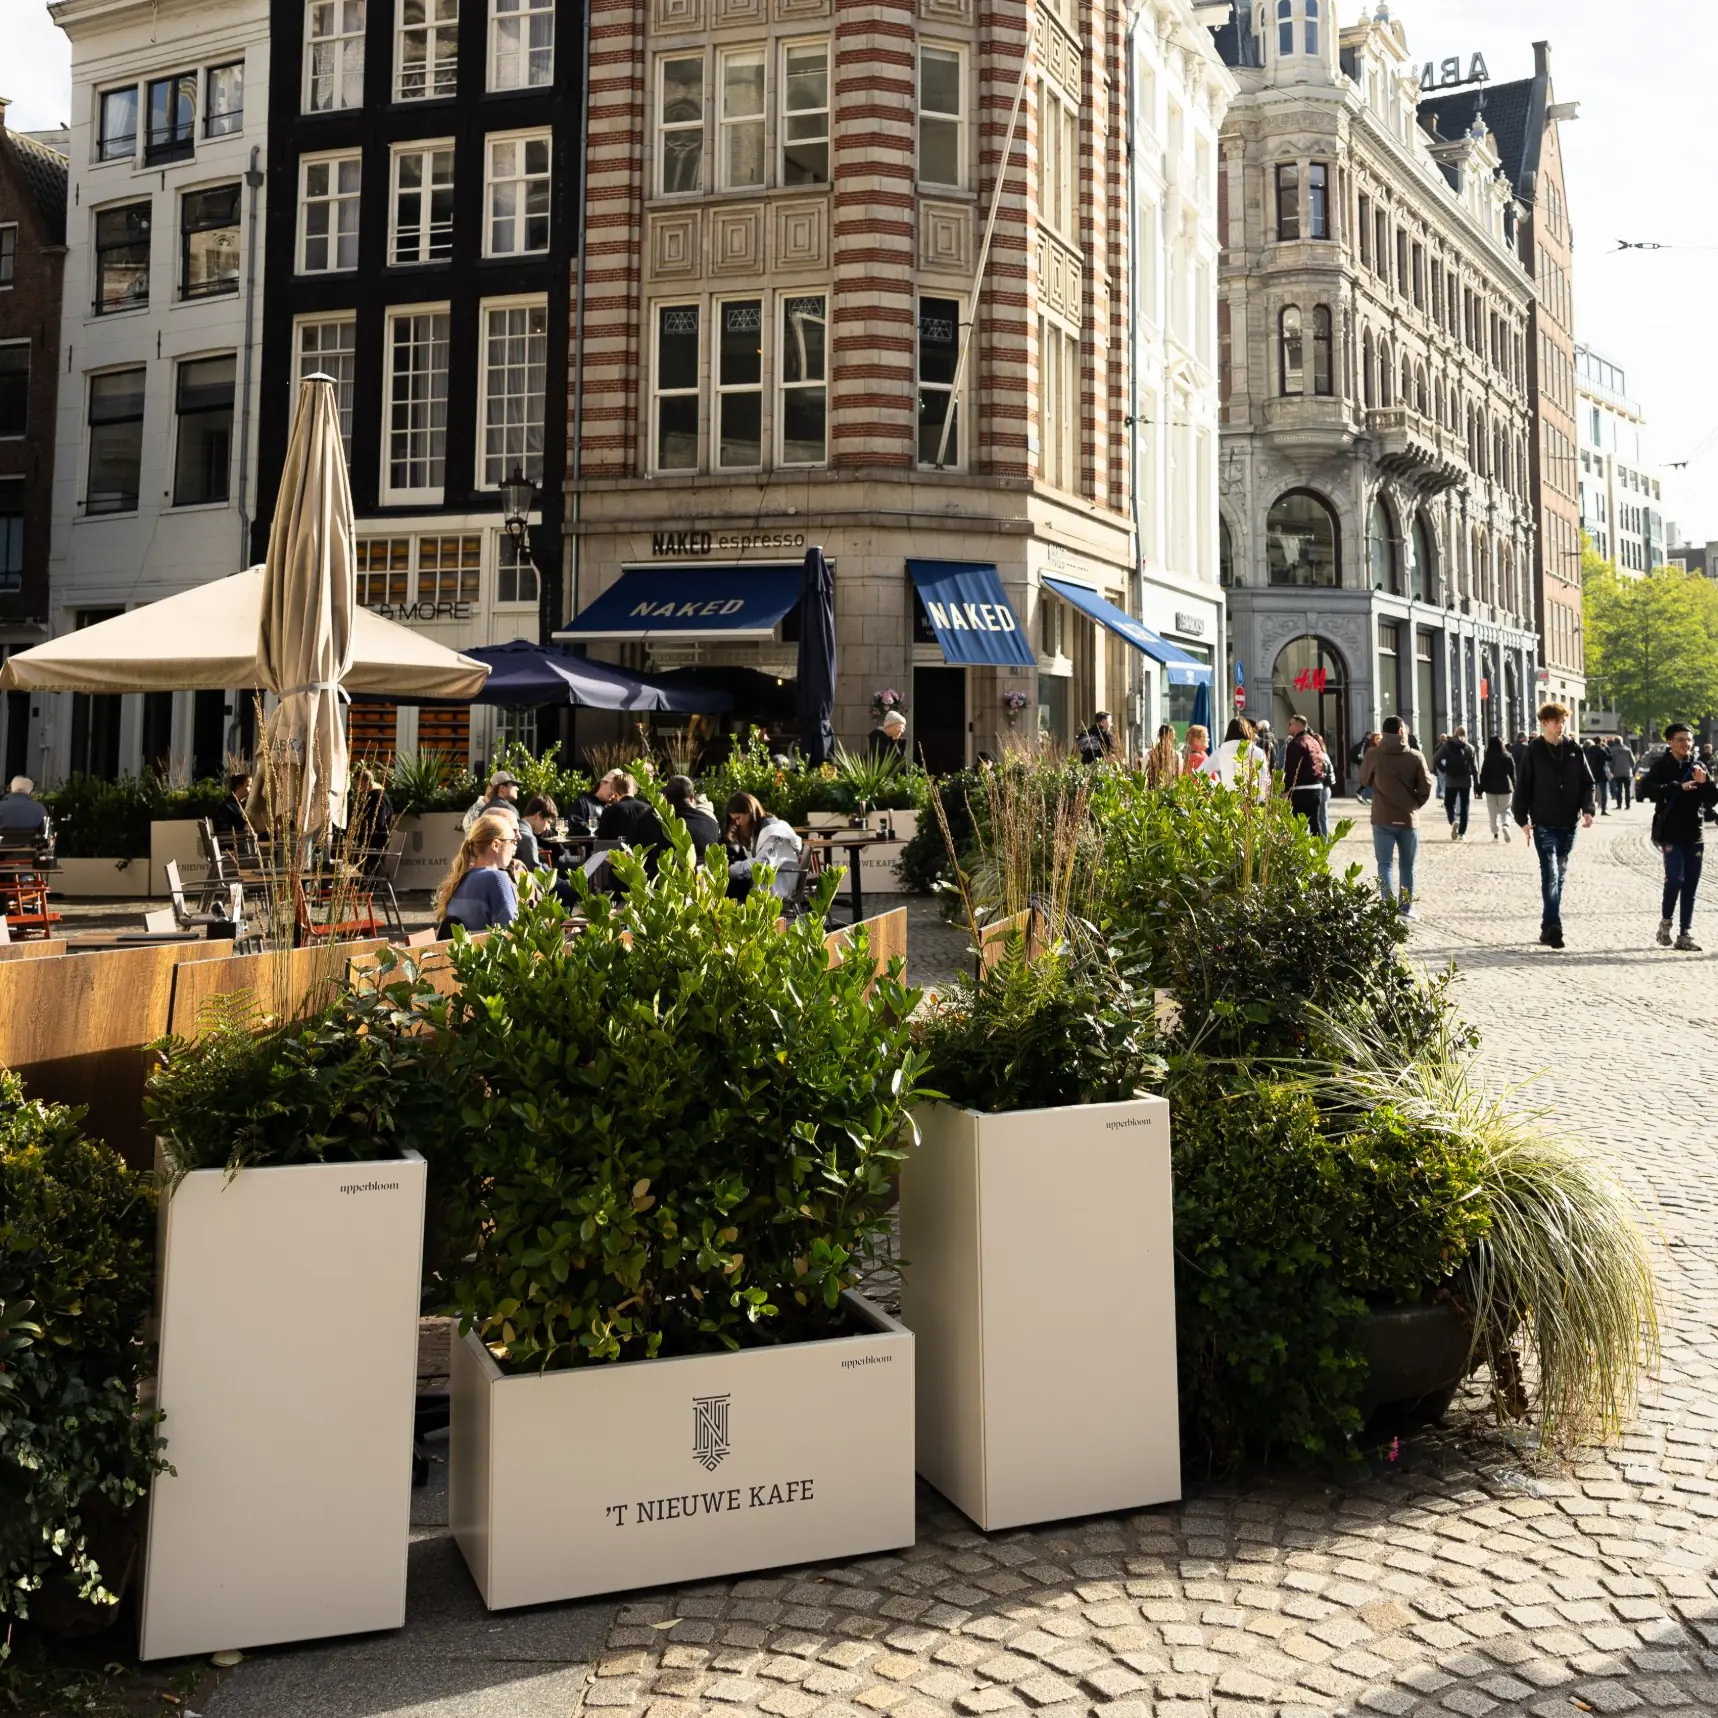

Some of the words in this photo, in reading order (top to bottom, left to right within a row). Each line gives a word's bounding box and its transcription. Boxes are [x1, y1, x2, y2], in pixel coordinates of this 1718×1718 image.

[652, 531, 712, 556] NAKED
[719, 533, 805, 554] espresso
[399, 601, 471, 620] MORE
[628, 599, 745, 617] NAKED
[927, 601, 1016, 632] NAKED
[1105, 1117, 1152, 1131] upperbloom
[340, 1181, 399, 1194] upperbloom
[841, 1355, 892, 1369] upperbloom
[606, 1504, 629, 1527] 'T
[636, 1488, 741, 1524] NIEUWE
[748, 1479, 815, 1508] KAFE
